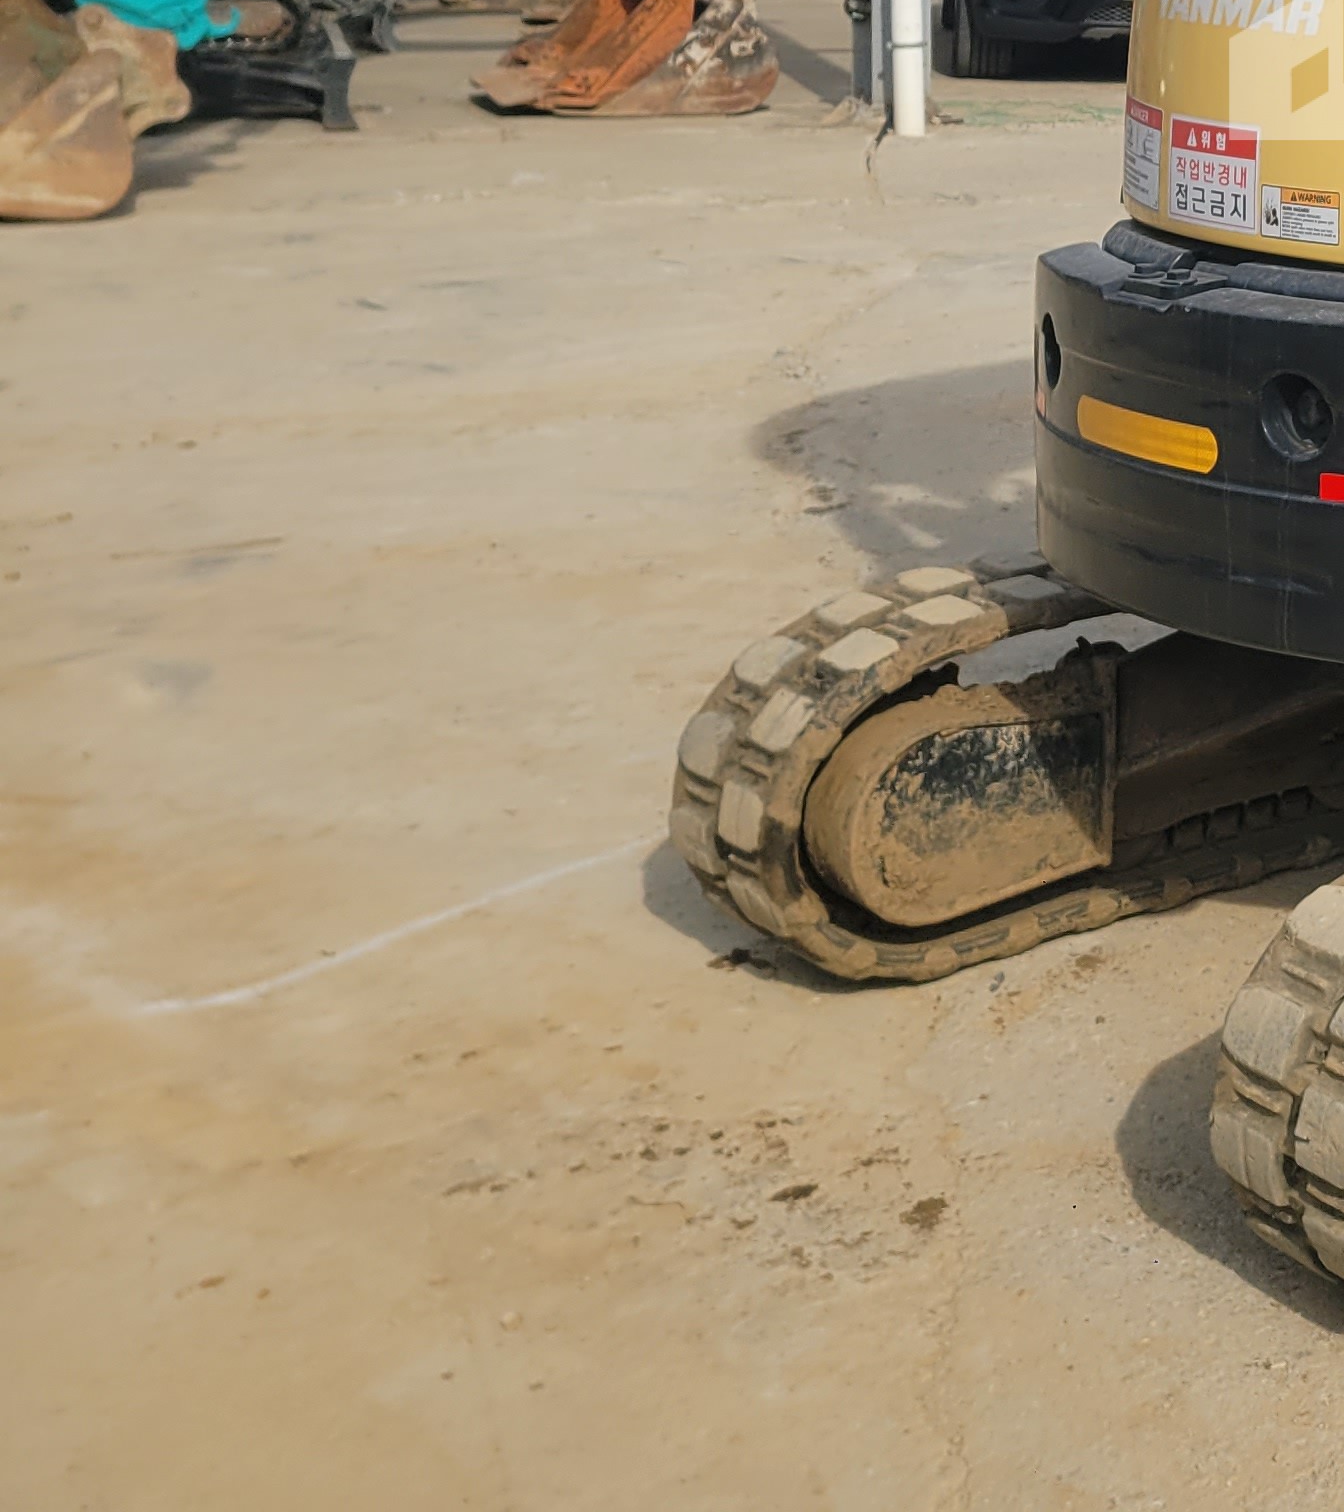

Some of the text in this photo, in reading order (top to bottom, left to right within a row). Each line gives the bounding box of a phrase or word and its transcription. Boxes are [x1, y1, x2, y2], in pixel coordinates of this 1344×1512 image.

[1175, 156, 1248, 188] 작업반경내
[1174, 182, 1247, 222] 접근금지
[1297, 191, 1332, 204] WARNING
